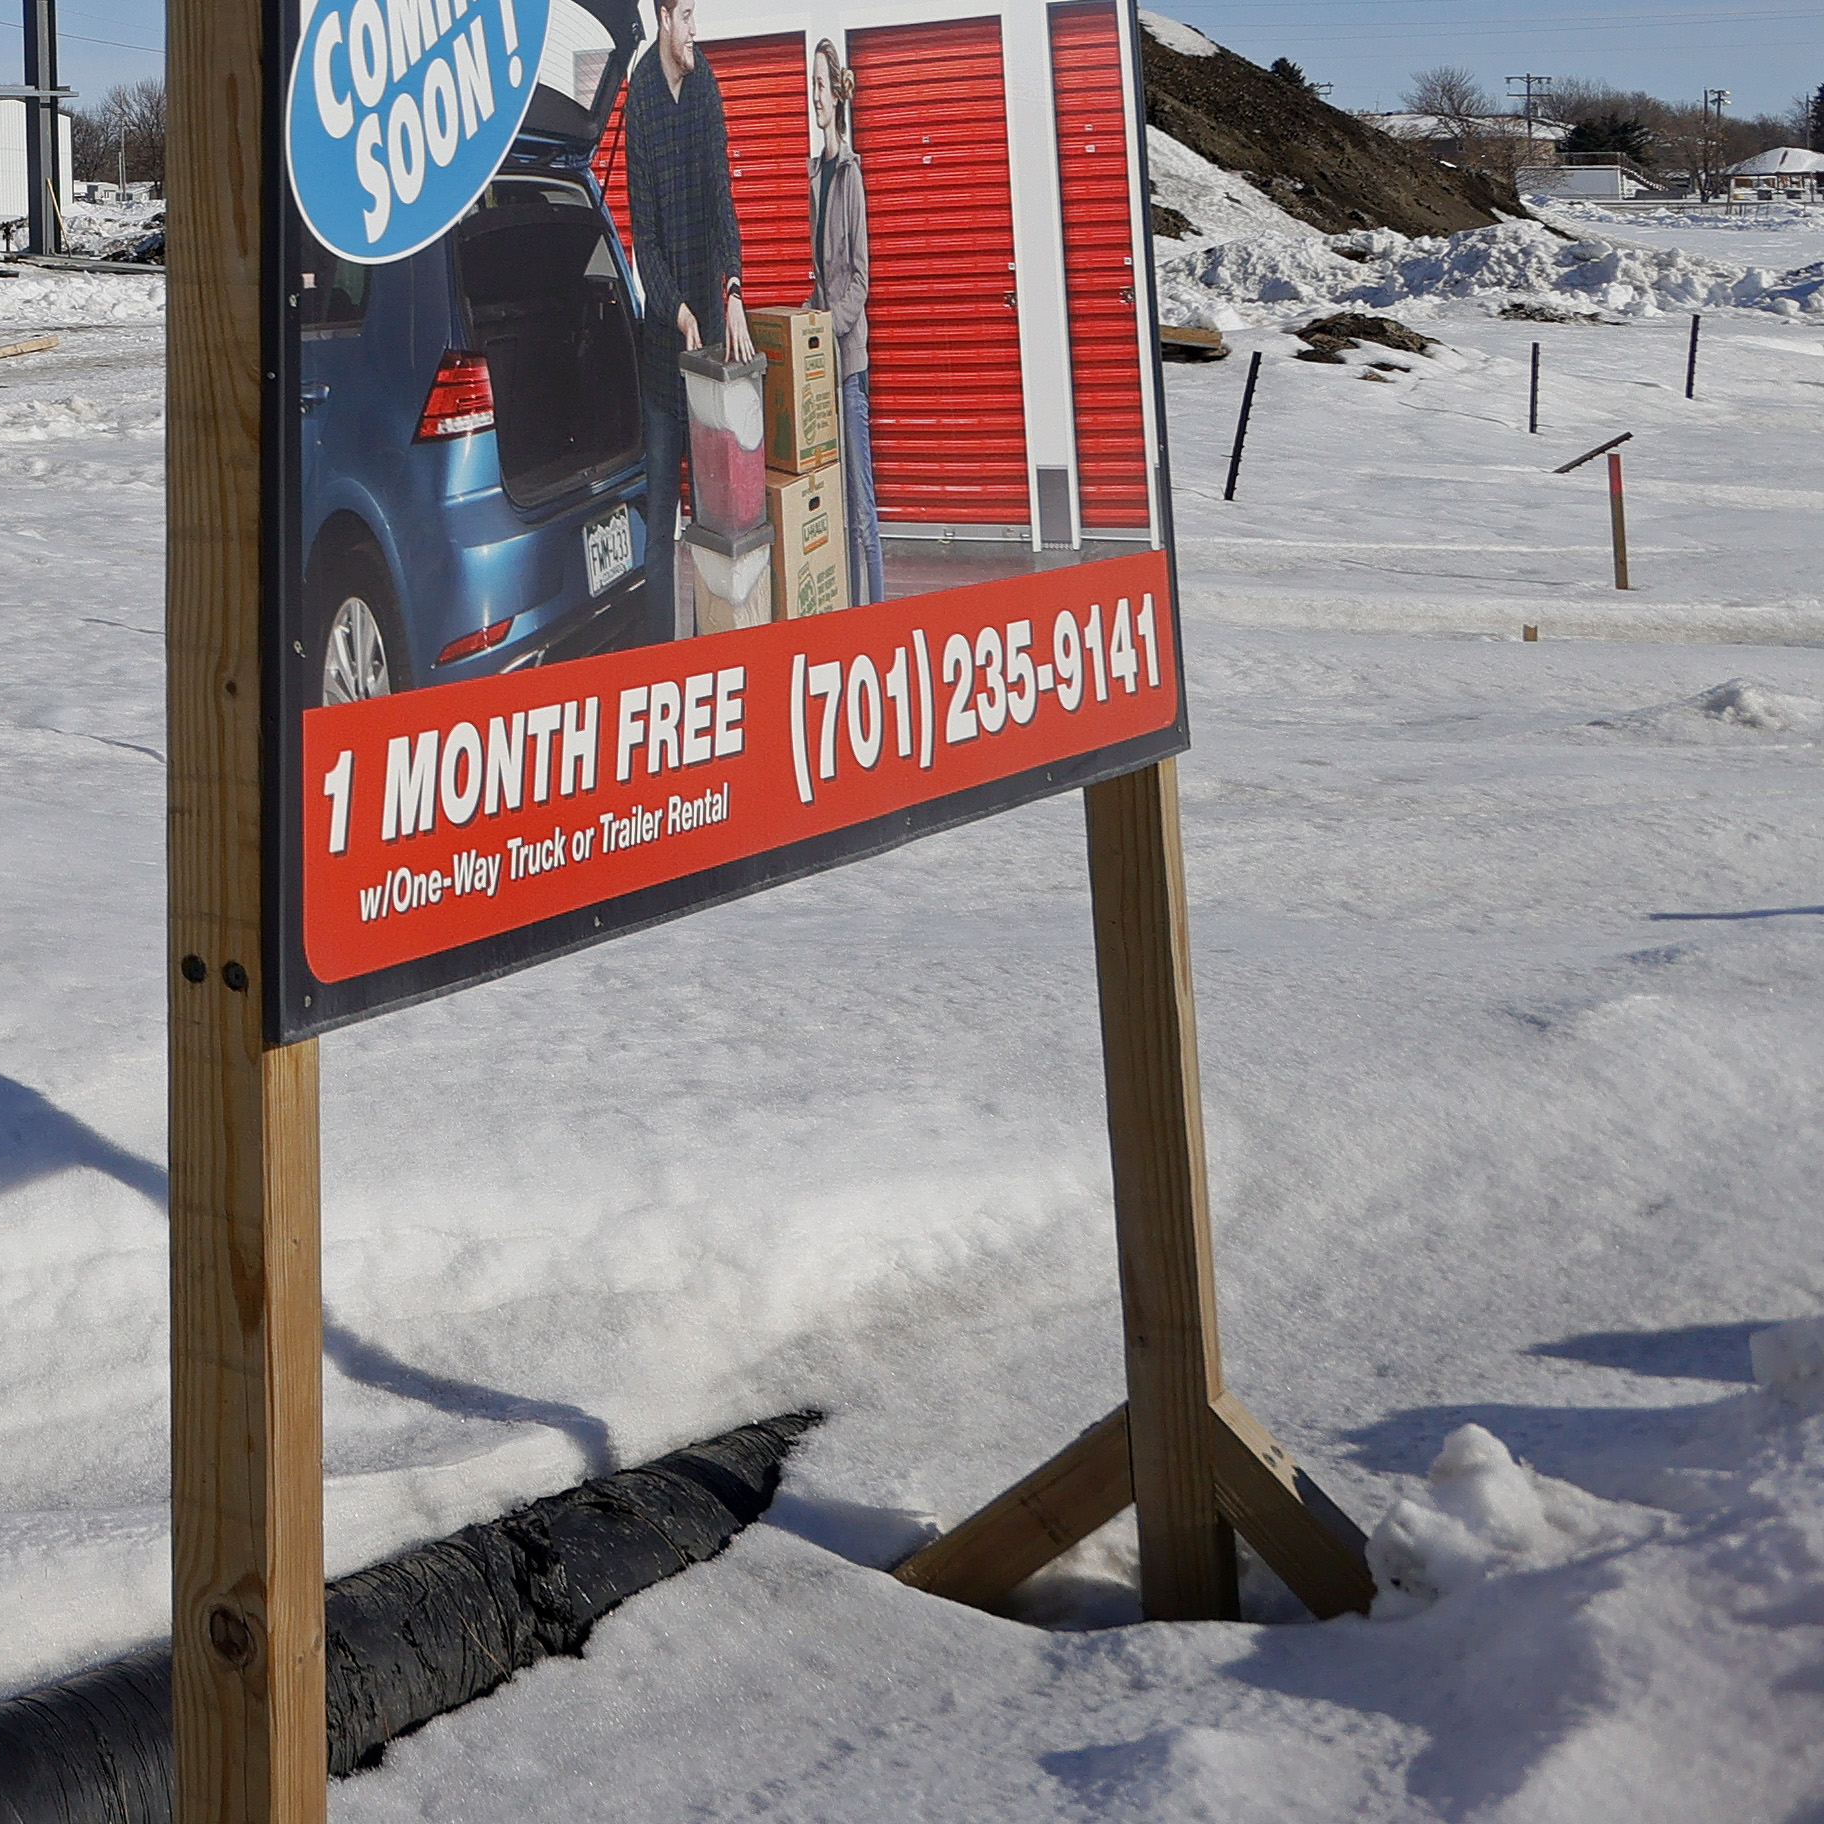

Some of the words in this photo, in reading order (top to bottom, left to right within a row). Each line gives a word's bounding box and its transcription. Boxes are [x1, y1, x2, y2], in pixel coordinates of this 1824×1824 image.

[324, 750, 354, 853] 1
[381, 696, 600, 842] MONTH
[616, 666, 746, 782] FREE
[789, 628, 935, 805] (701)
[944, 592, 1161, 746] 235-9141
[359, 849, 501, 923] w/One-Way
[506, 826, 566, 880] Truck
[571, 829, 596, 862] or
[599, 807, 664, 855] Trailer
[667, 782, 730, 836] Rental
